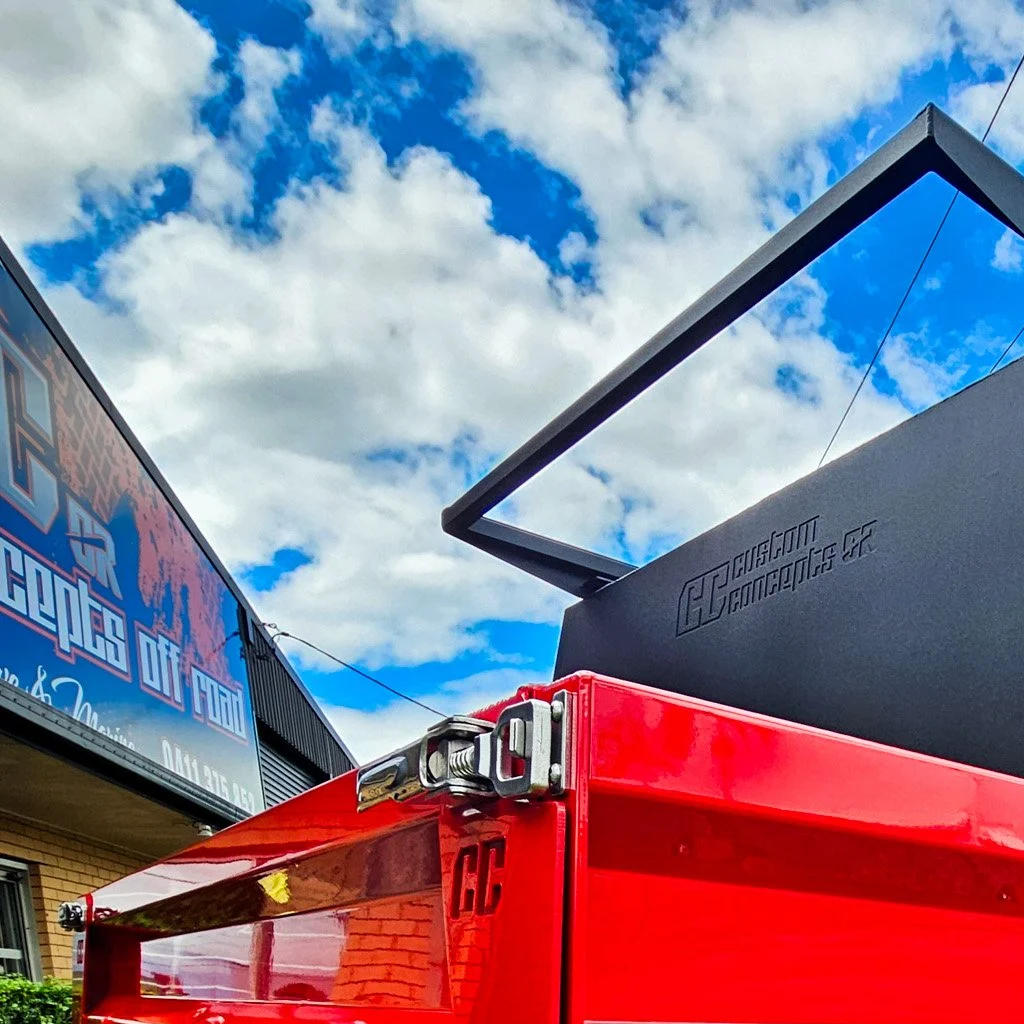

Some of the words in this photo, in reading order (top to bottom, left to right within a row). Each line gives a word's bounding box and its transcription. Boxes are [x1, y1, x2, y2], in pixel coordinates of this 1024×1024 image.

[138, 630, 183, 704] off
[191, 665, 247, 741] road
[451, 836, 507, 921] CC
